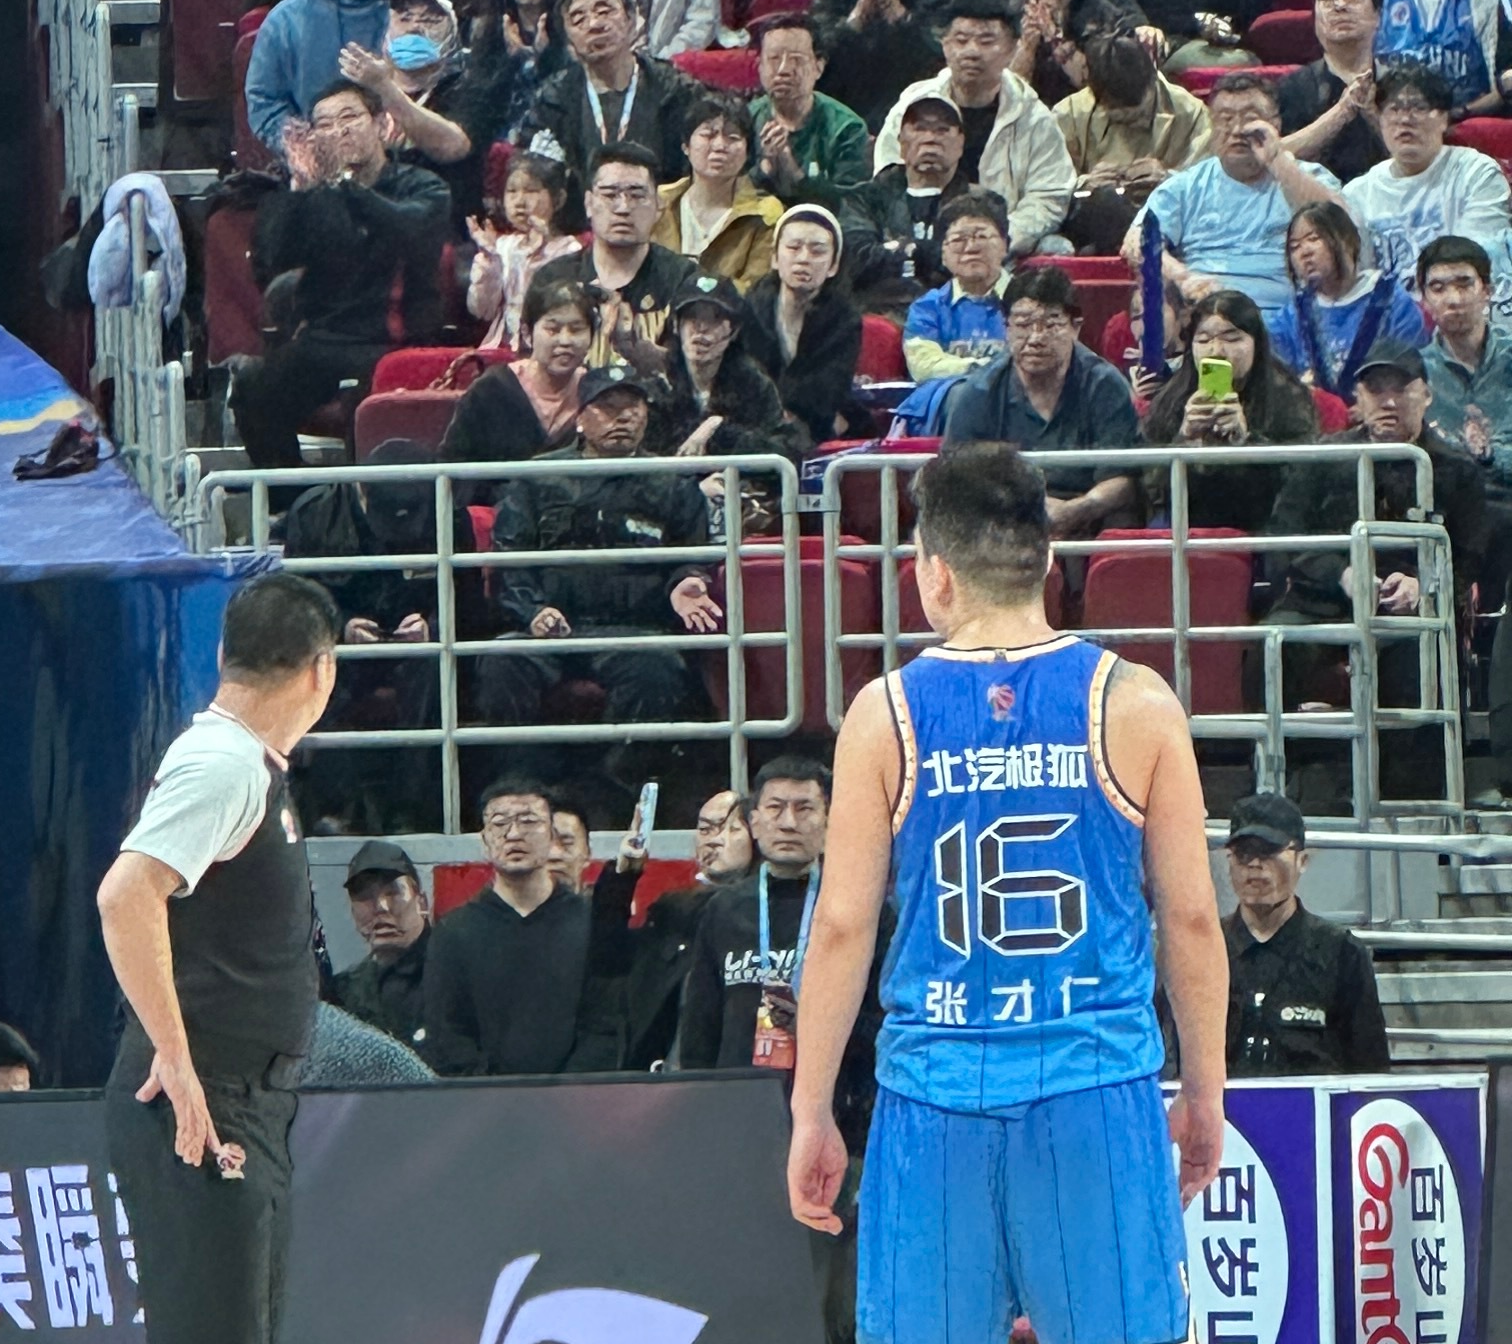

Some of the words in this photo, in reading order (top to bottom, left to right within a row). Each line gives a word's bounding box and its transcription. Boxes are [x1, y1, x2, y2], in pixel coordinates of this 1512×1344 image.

[922, 742, 1088, 797] 北汽极狐
[934, 813, 1088, 961] 16
